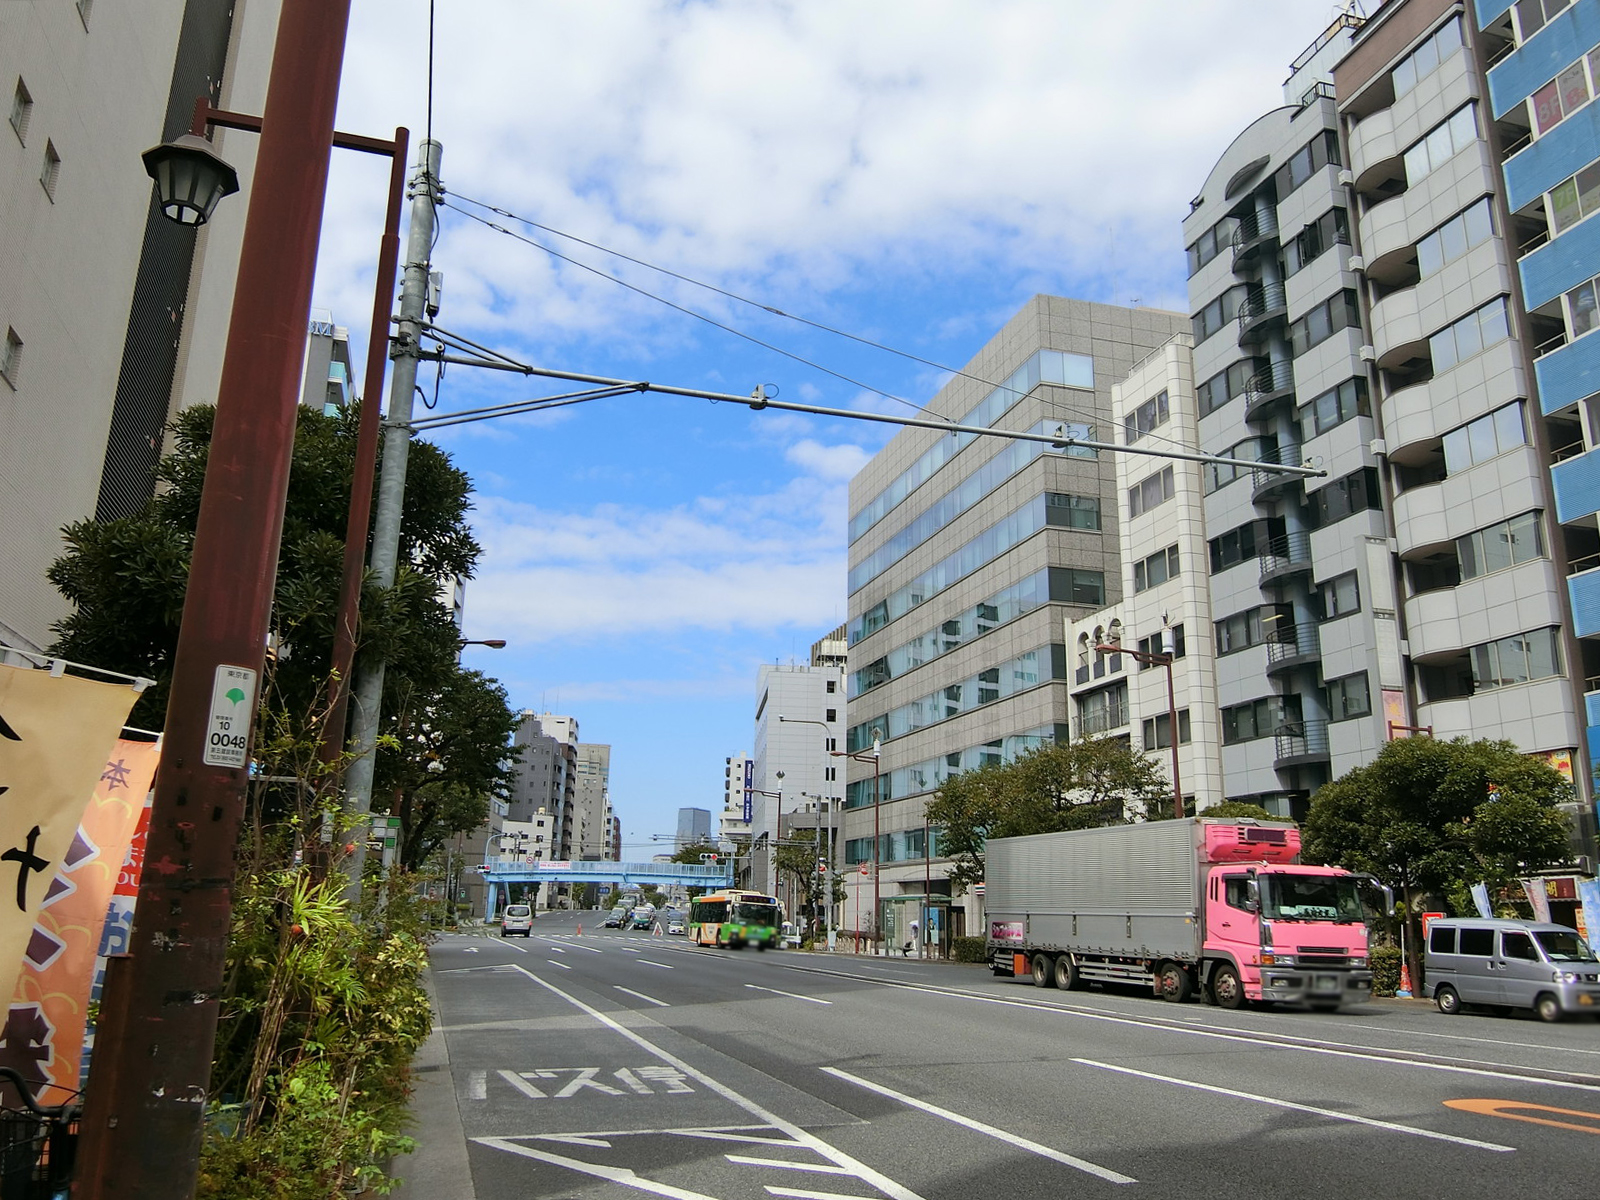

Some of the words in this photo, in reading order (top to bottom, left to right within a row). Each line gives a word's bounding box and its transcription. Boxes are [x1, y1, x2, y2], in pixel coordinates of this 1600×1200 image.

[1540, 94, 1558, 123] 8F
[219, 721, 230, 735] 10
[210, 732, 246, 749] 0048
[466, 1066, 696, 1099] バス停
